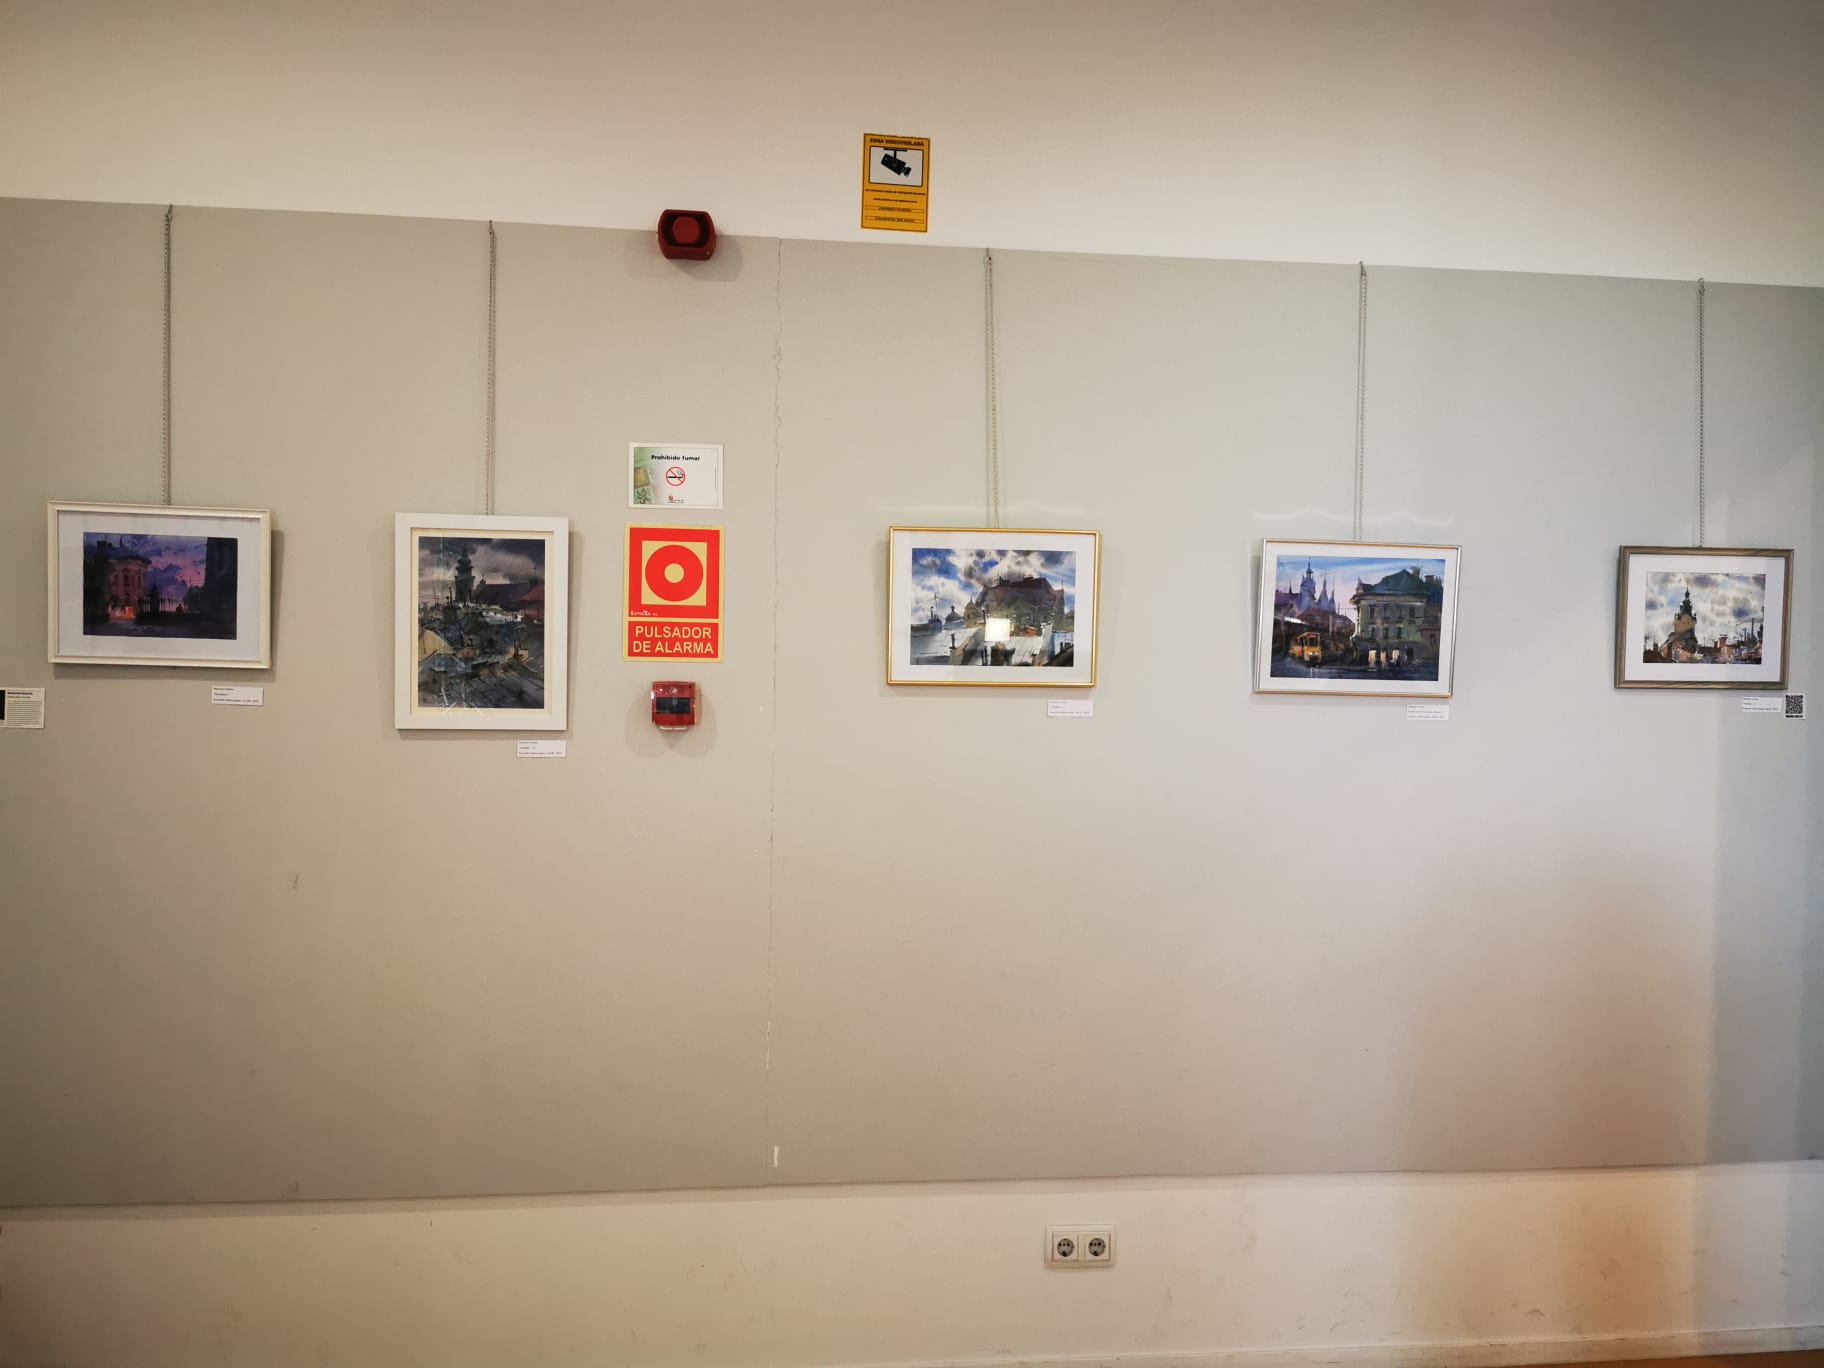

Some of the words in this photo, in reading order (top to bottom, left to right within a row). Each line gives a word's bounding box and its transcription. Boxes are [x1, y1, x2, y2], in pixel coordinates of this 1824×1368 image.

[885, 139, 925, 147] VIDEOVIGILADA
[635, 625, 712, 639] PULSADOR
[632, 640, 652, 653] DE
[654, 641, 714, 654] ALARMA
